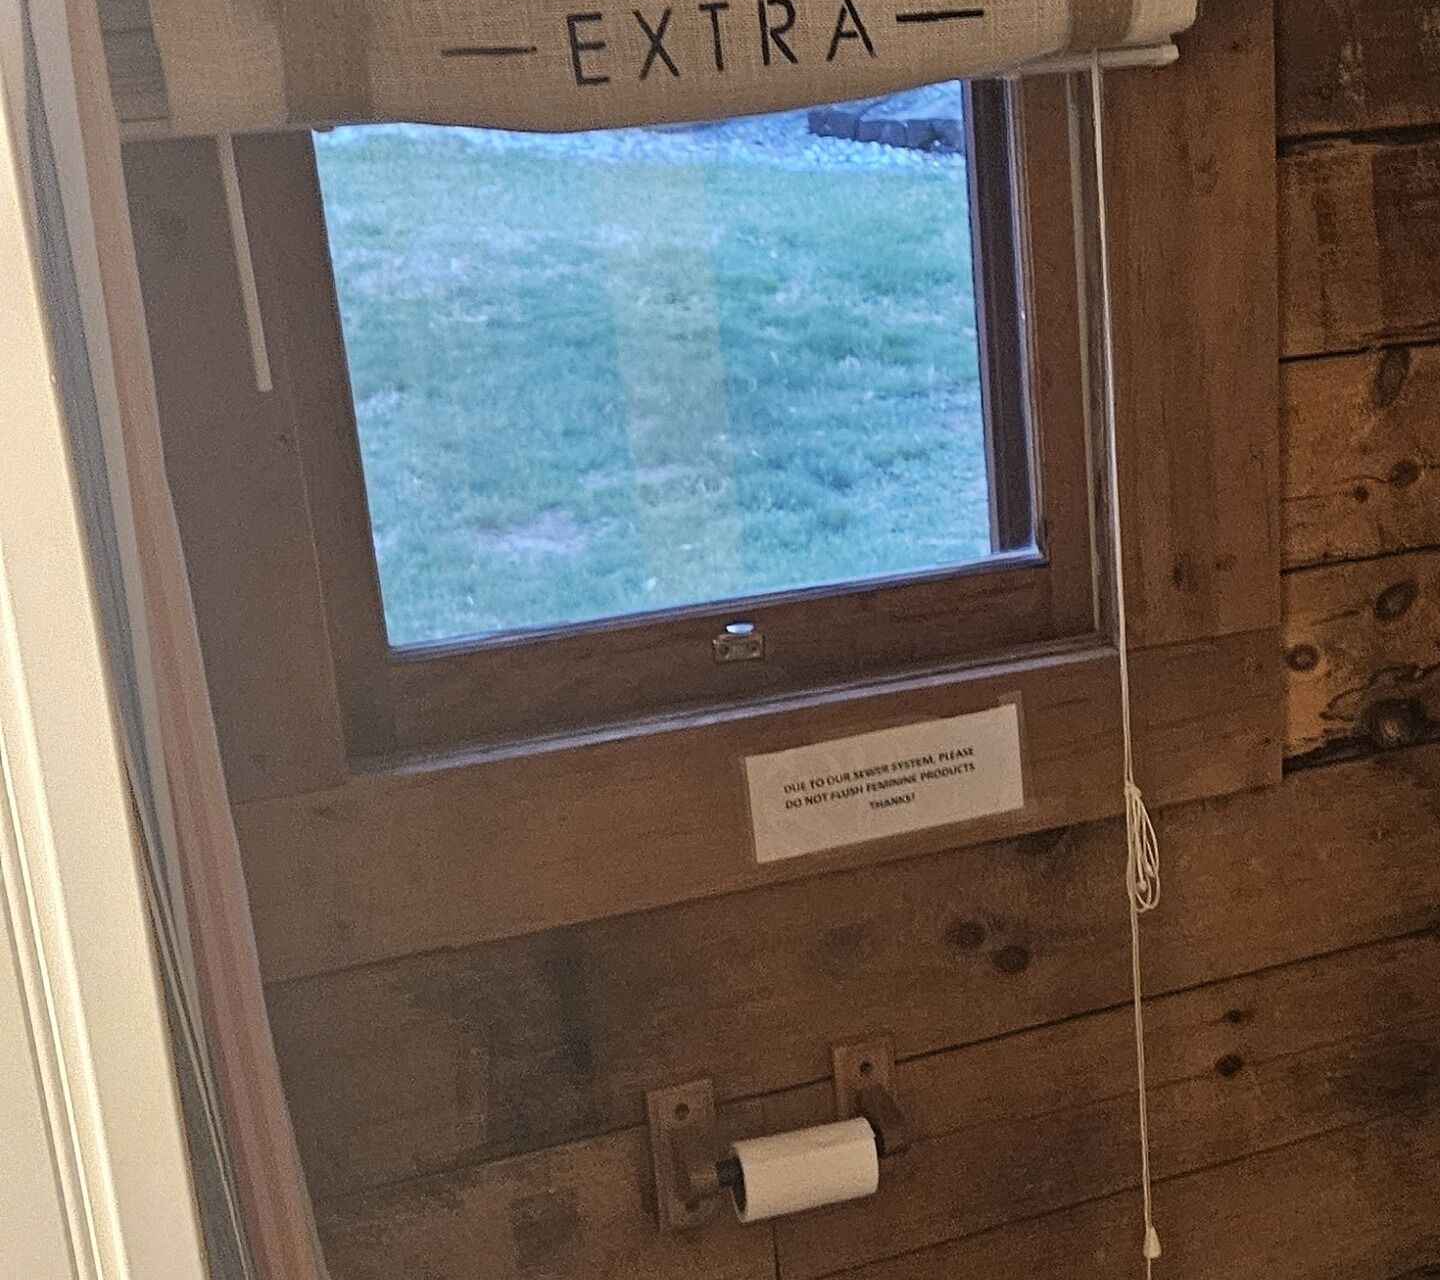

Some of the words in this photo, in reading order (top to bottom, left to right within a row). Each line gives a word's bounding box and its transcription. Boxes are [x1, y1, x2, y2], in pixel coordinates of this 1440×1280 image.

[783, 781, 807, 795] DUE
[810, 778, 825, 789] TO
[827, 772, 851, 786] OUR
[939, 747, 975, 762] PLEASE
[785, 798, 802, 810] DO
[804, 792, 828, 806] NOT
[830, 785, 863, 800] FLUSH
[866, 773, 917, 792] FEMININE
[920, 761, 976, 782] PRODUCTS
